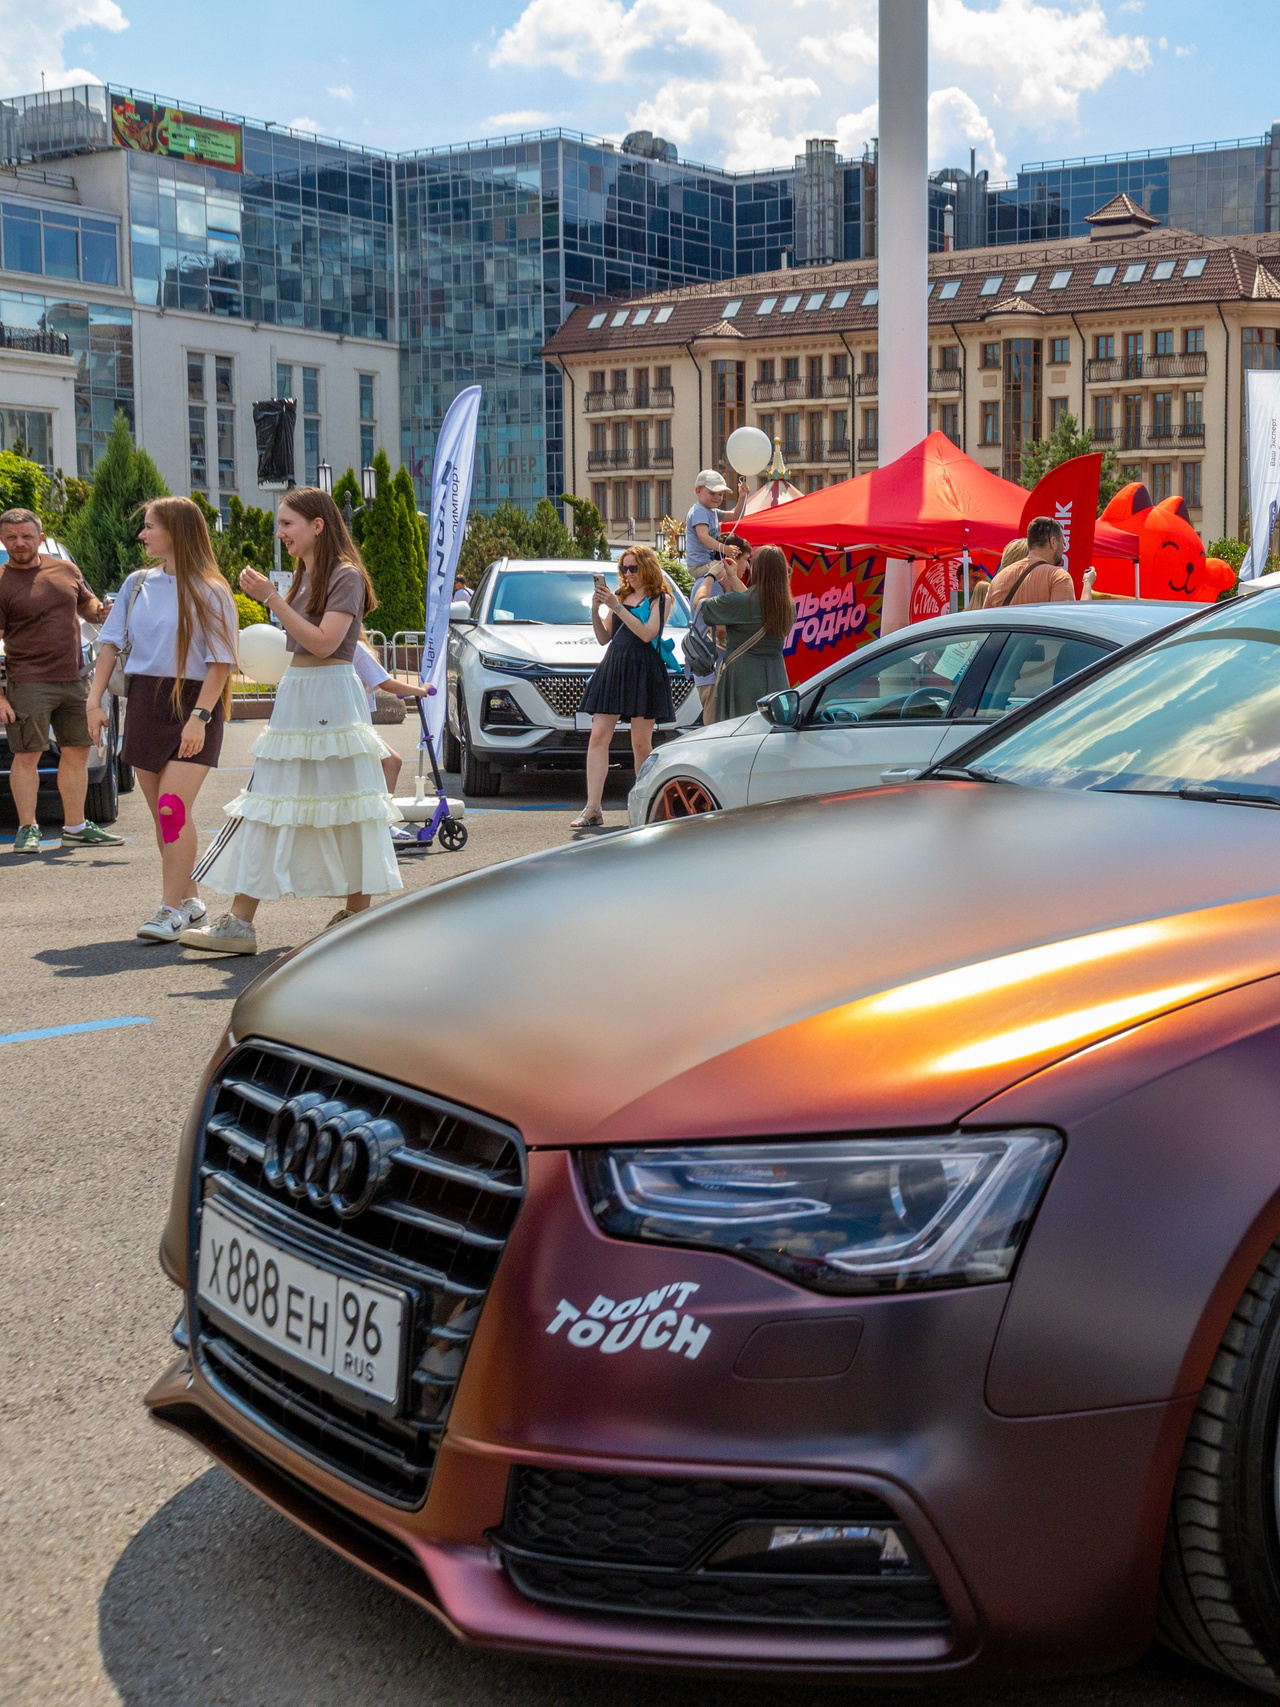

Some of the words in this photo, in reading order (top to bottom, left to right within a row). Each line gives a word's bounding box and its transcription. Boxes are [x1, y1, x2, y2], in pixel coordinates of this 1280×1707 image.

[1269, 449, 1277, 467] Ваш
[793, 582, 854, 620] ЛЬФА
[913, 583, 939, 615] СТИЛЬ
[783, 603, 866, 649] ГОДНО
[209, 1237, 328, 1357] Х888ЕН
[342, 1291, 382, 1356] 96
[586, 1281, 700, 1322] DON'T
[545, 1298, 712, 1360] TOUCH
[344, 1352, 375, 1383] RUS
